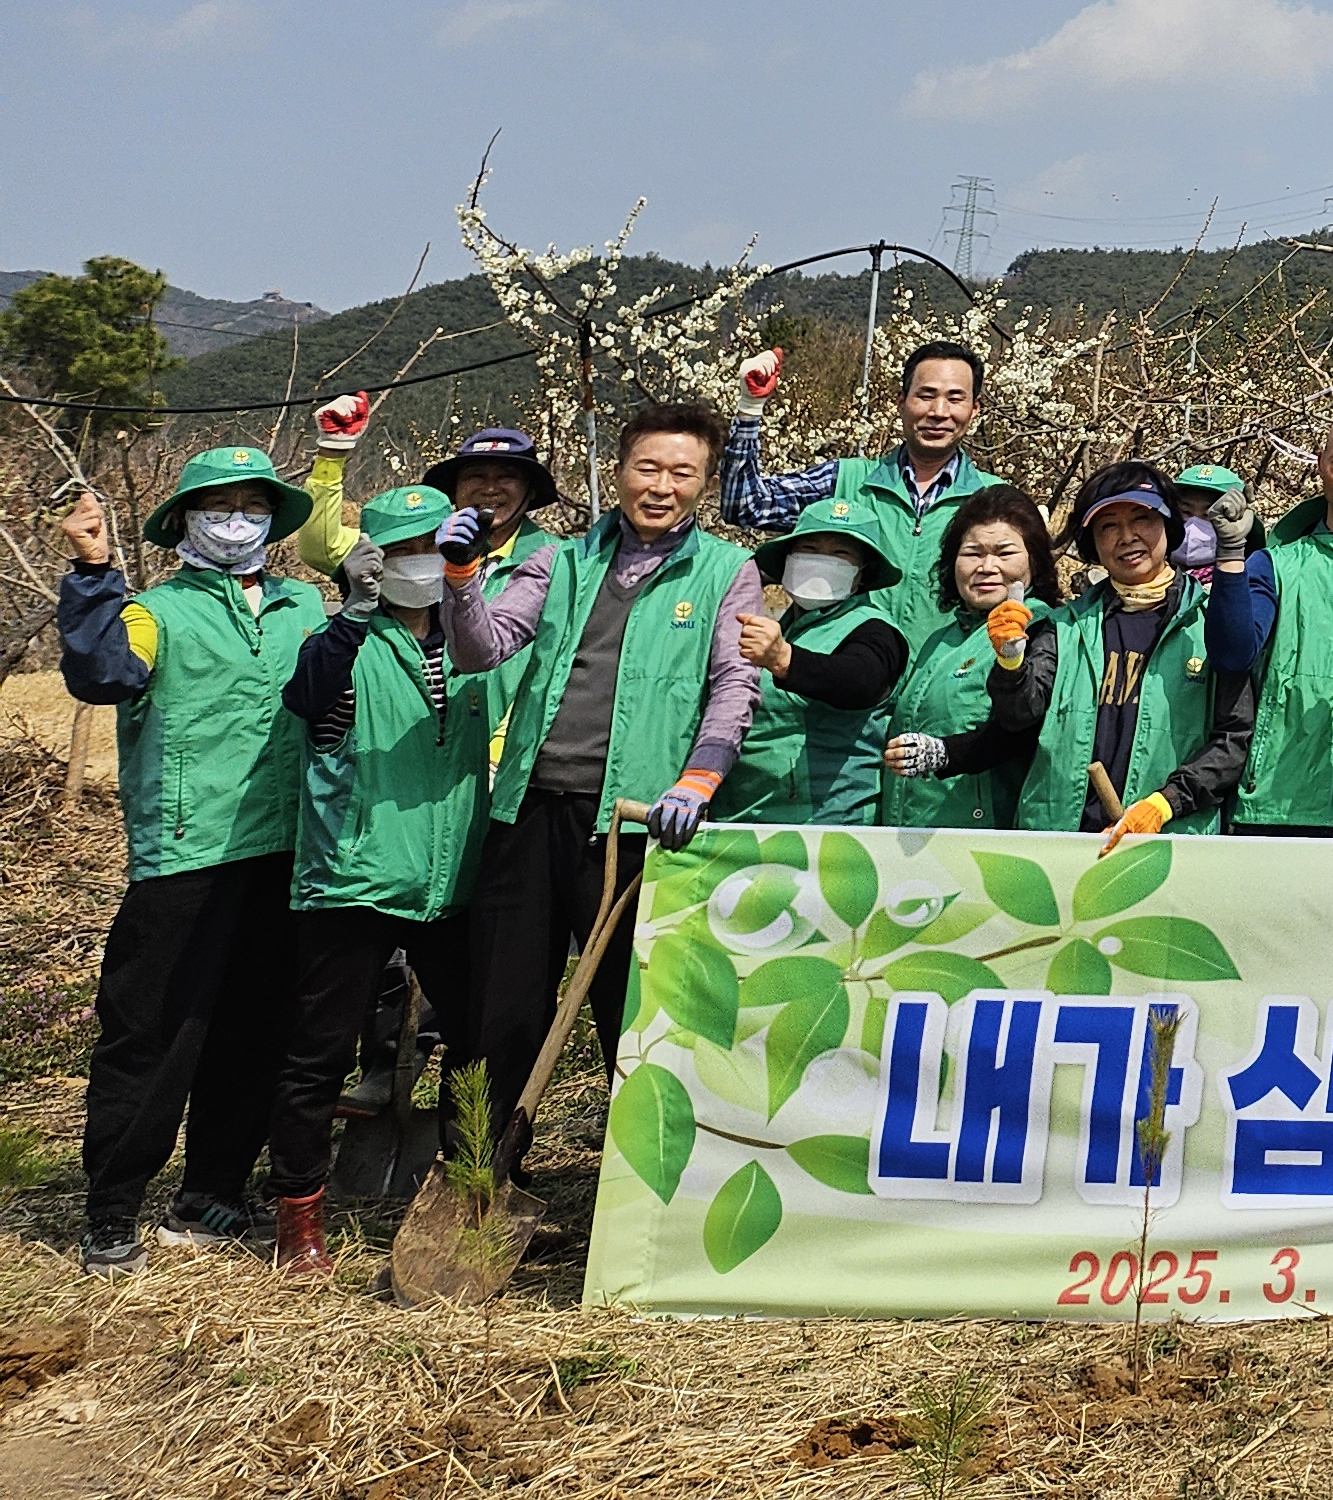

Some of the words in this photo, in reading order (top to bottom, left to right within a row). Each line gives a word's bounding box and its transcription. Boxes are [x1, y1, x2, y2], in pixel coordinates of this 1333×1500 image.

[879, 1000, 1184, 1186] 내가
[1059, 1252, 1228, 1304] 2025.
[1264, 1249, 1314, 1302] 3.
